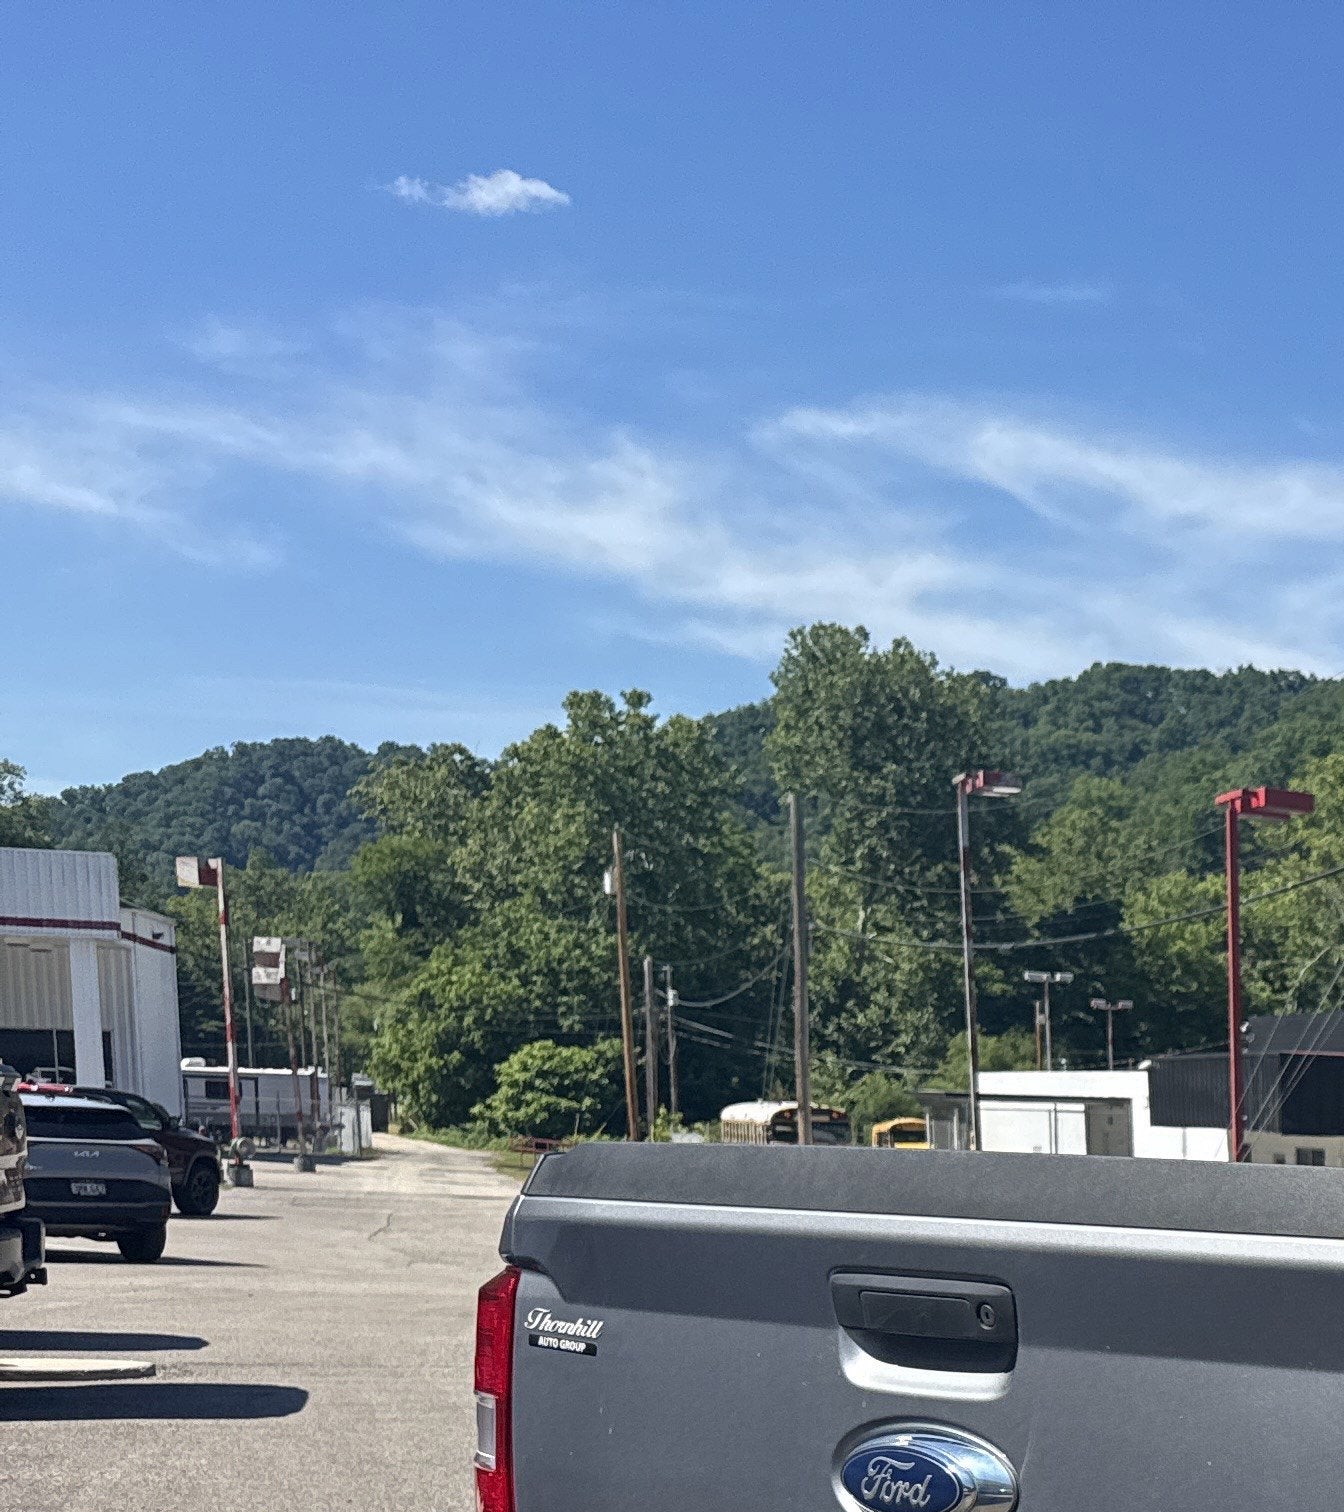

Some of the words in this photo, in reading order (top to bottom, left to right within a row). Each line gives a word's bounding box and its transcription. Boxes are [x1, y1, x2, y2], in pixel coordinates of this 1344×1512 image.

[524, 1307, 604, 1339] Thornhill
[538, 1336, 559, 1349] AUTO
[560, 1339, 587, 1353] GROUP
[861, 1456, 933, 1508] Ford
